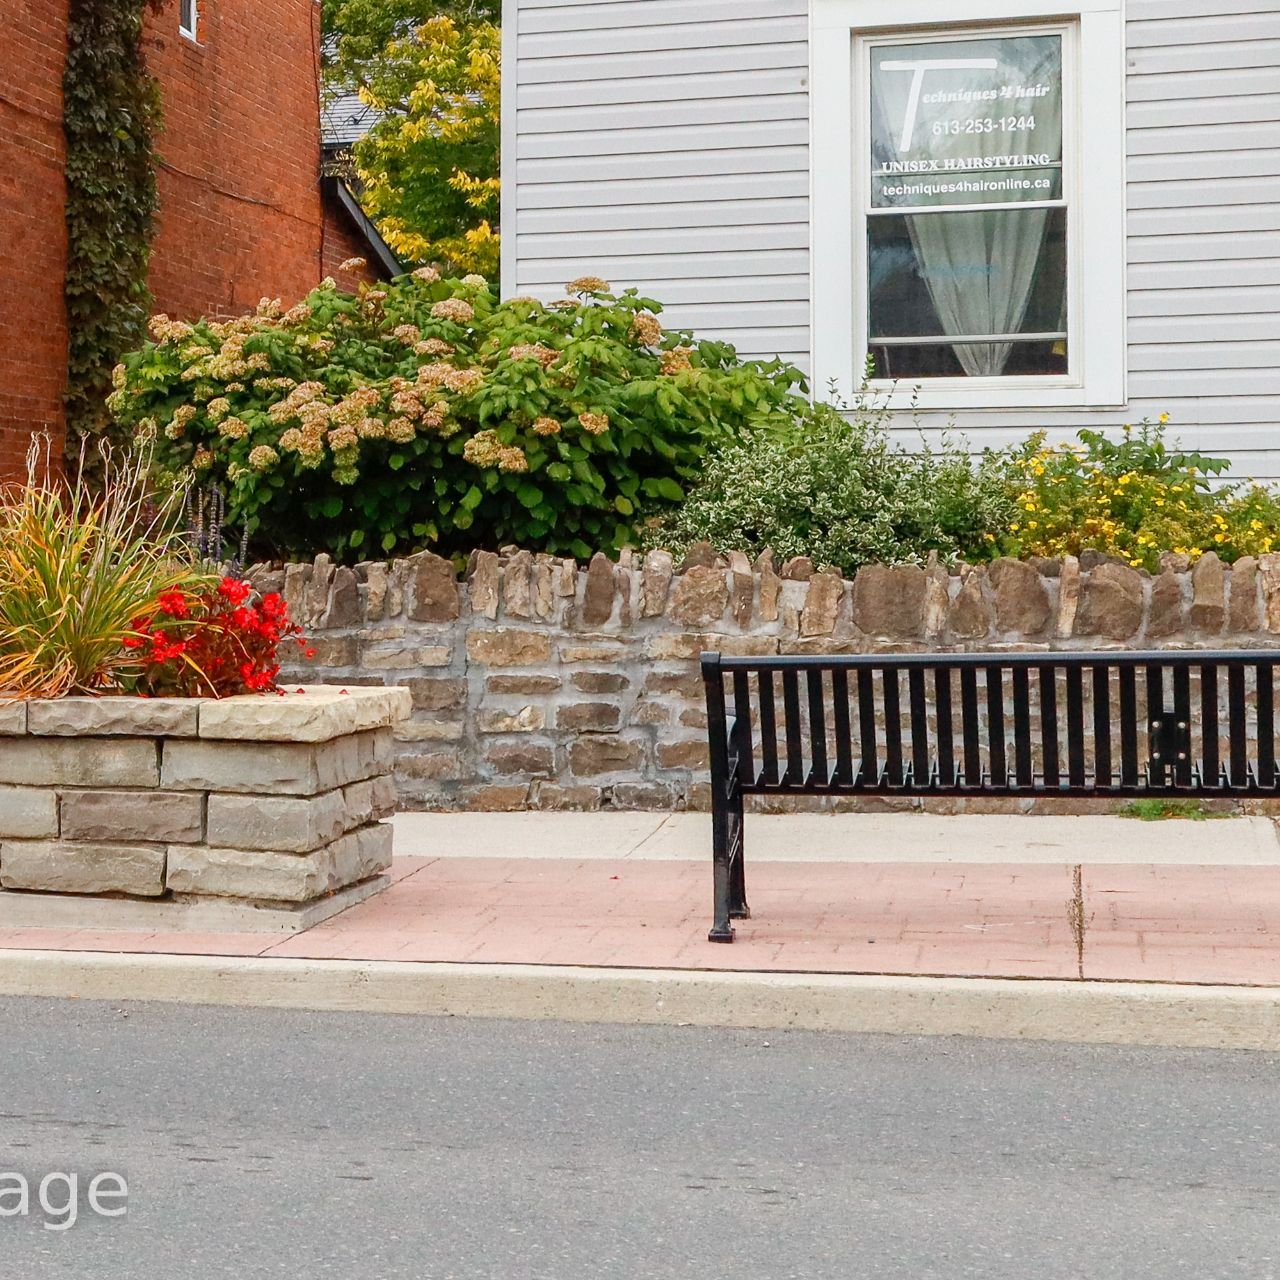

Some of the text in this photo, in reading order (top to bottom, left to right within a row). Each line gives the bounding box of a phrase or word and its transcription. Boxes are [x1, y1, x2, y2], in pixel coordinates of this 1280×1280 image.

[1015, 84, 1050, 98] hair
[932, 115, 1036, 135] 613-253-1244
[882, 154, 1051, 173] UNISEX HAIRSTYLING
[883, 178, 1051, 196] techniques4haironline.ca
